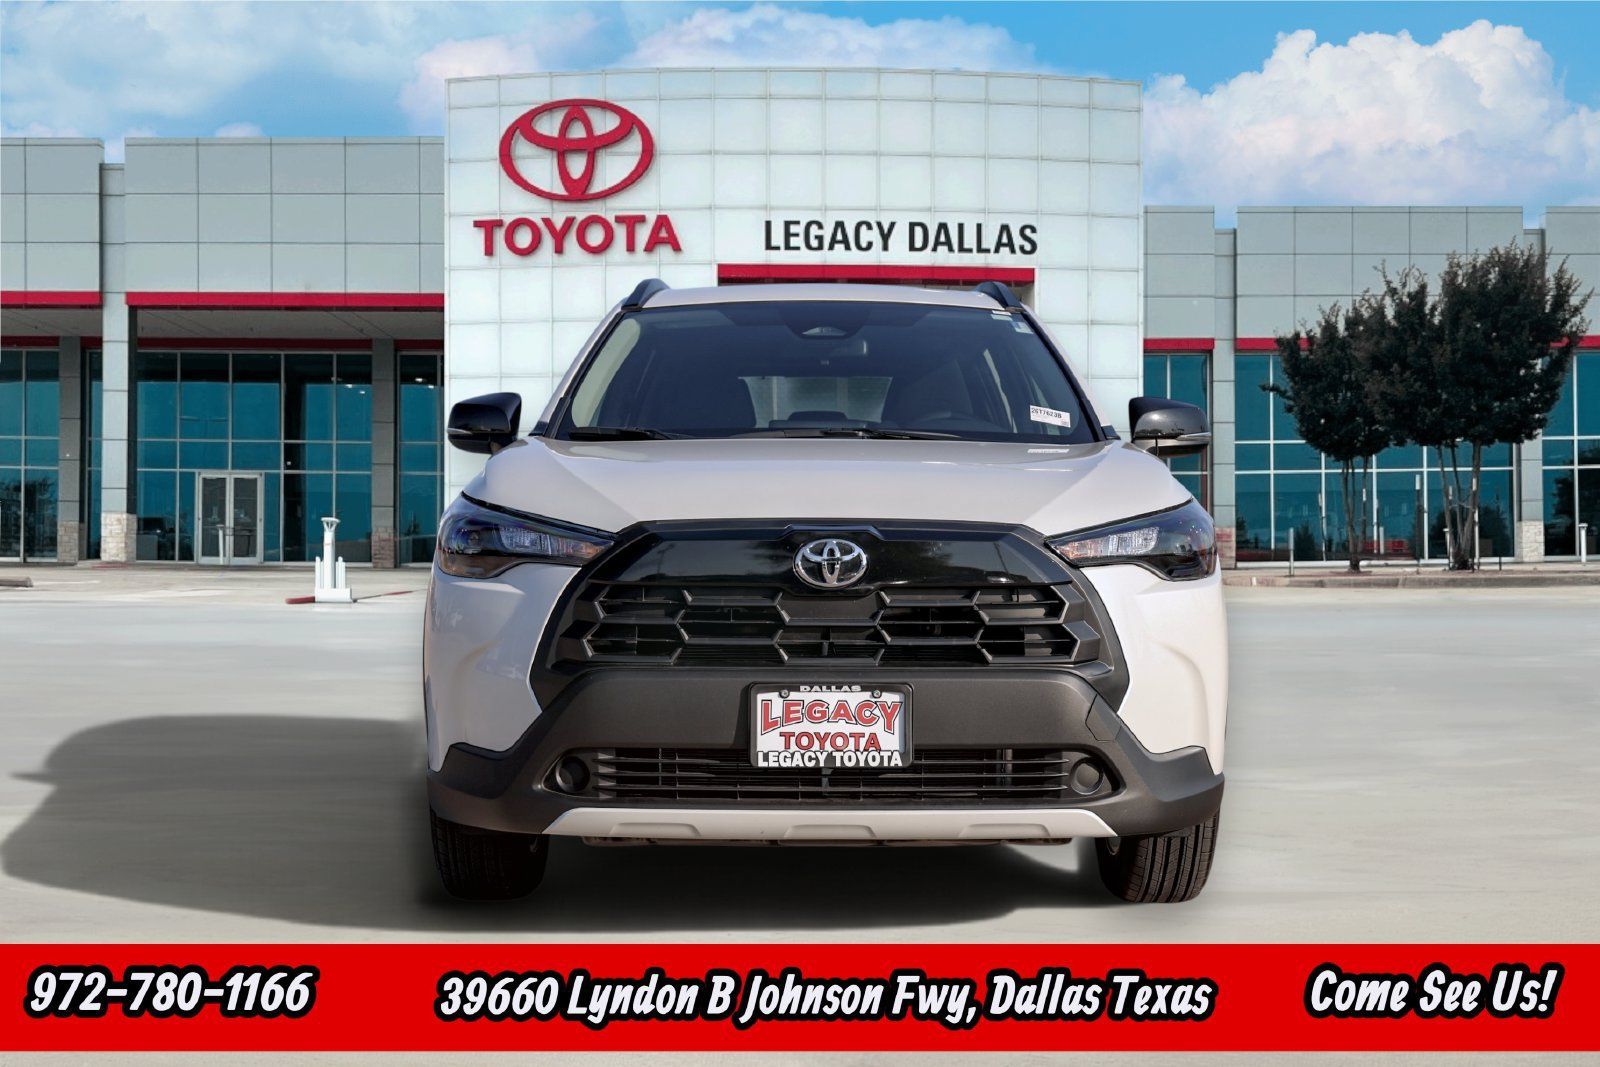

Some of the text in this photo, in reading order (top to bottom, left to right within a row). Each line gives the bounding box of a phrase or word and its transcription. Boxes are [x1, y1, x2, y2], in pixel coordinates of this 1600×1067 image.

[473, 214, 682, 257] TOYOTA
[764, 219, 1038, 256] LEGACY DALLAS
[761, 699, 903, 734] LEGACY
[780, 732, 881, 750] TOYOTA
[757, 751, 902, 767] LEGACY TOYOTA
